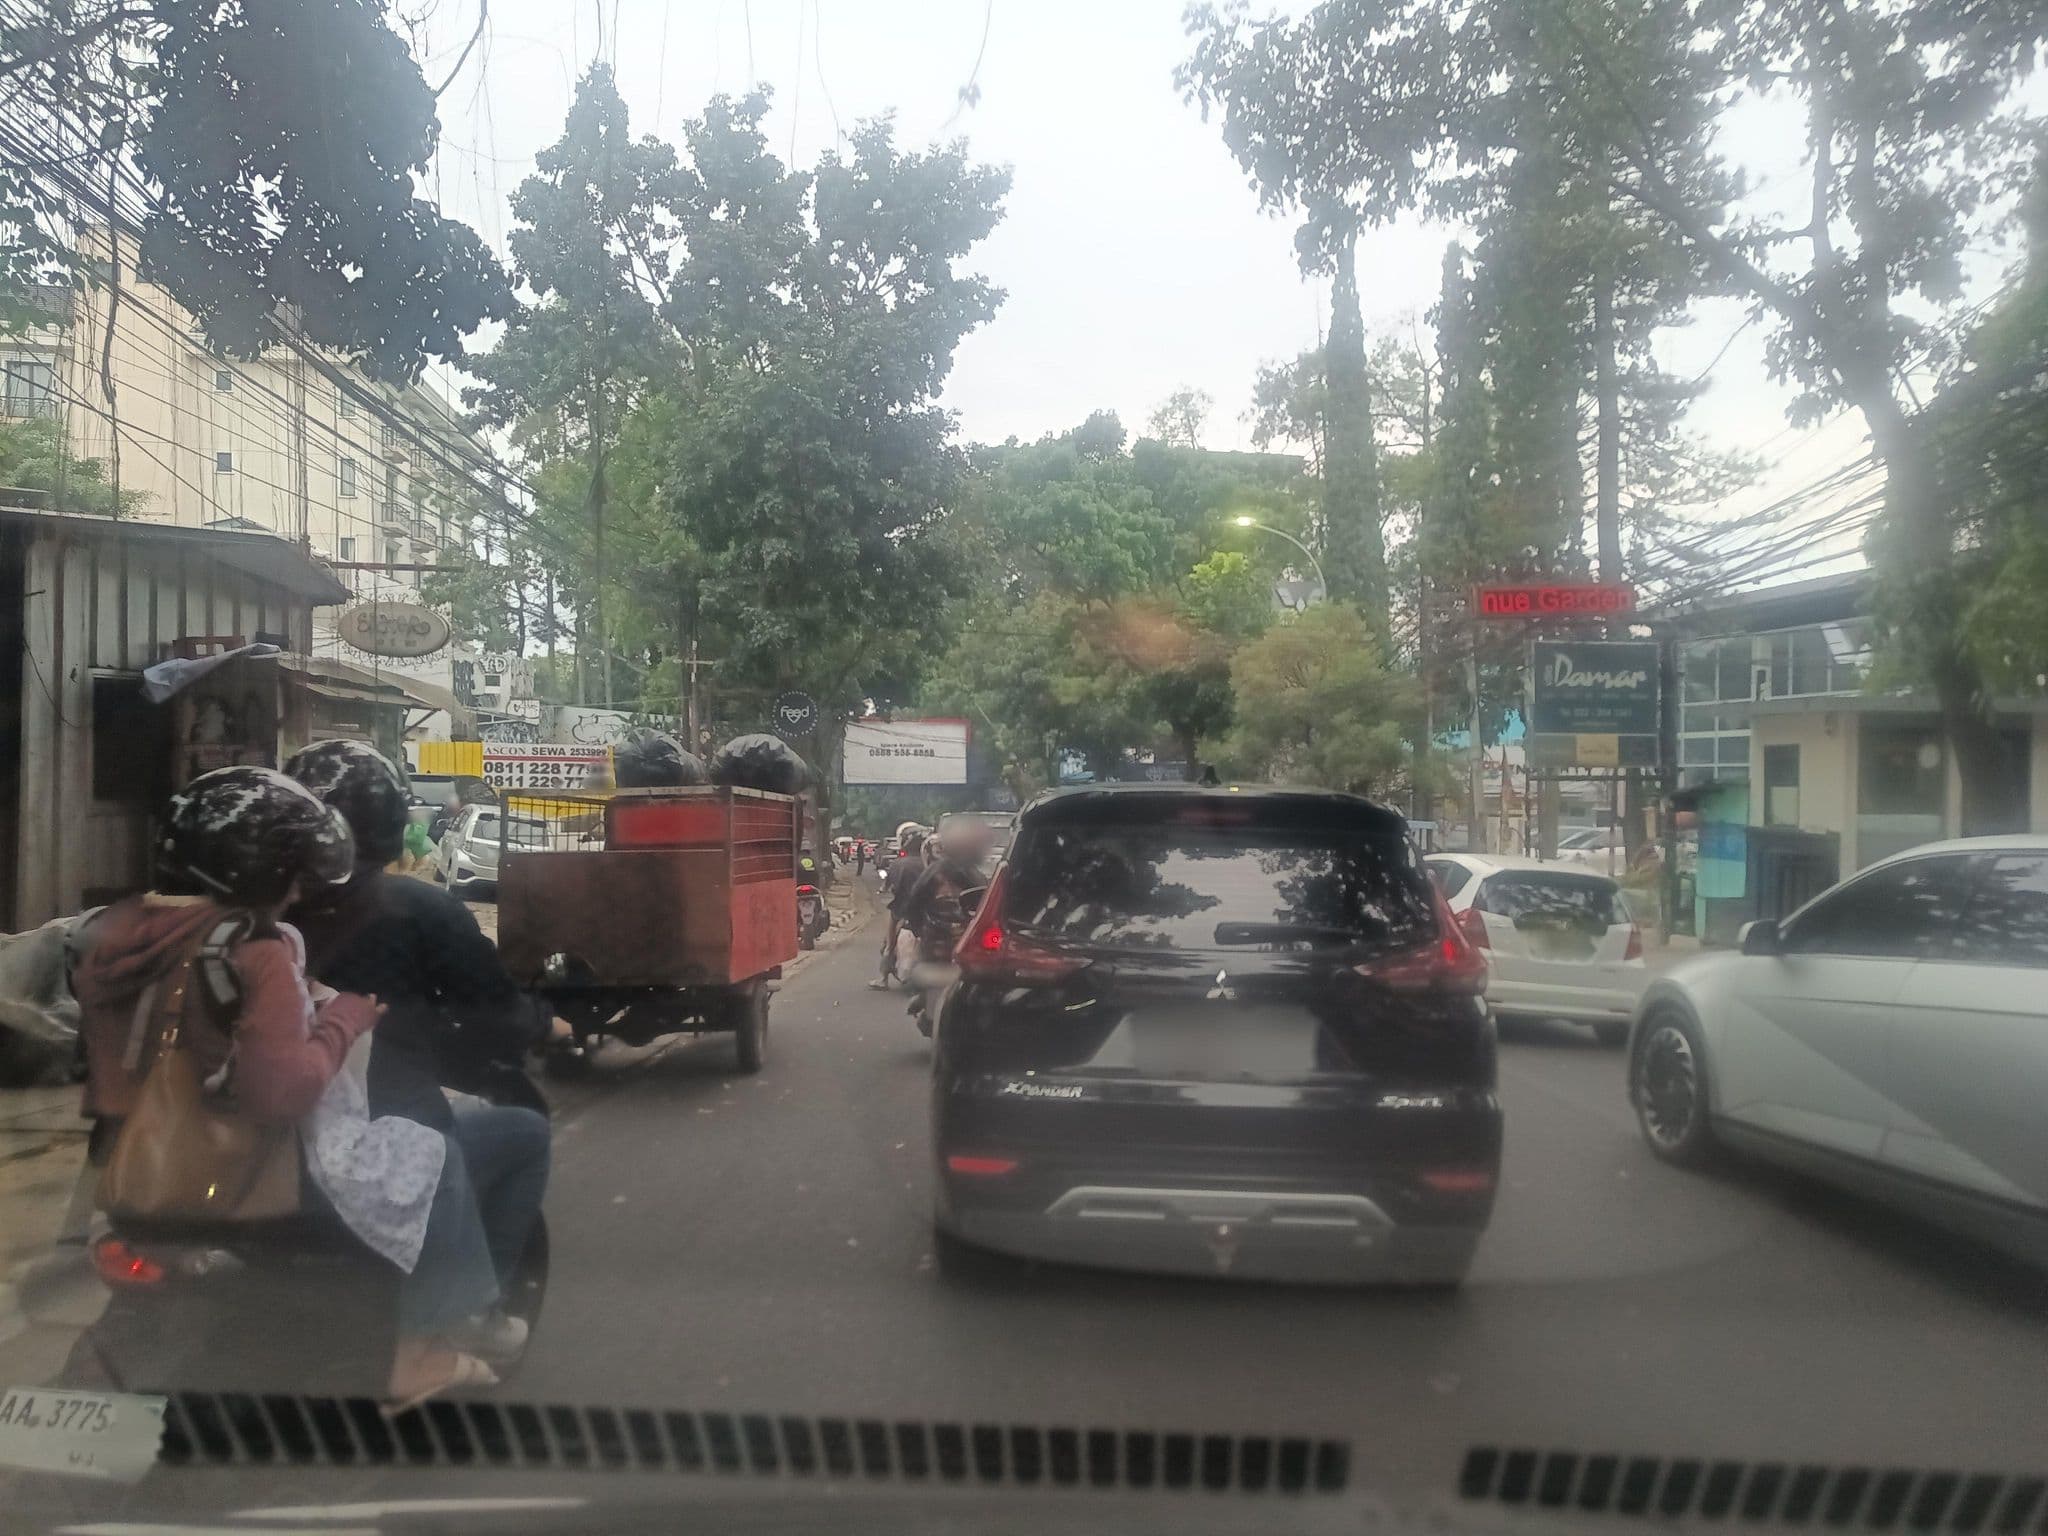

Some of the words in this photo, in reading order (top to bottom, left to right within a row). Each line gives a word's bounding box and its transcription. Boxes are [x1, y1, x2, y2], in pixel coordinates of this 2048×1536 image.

[1538, 587, 1631, 612] Garden
[1553, 653, 1647, 688] Damar
[485, 746, 526, 755] ASCON
[532, 747, 566, 756] SEWA
[484, 761, 524, 774] 0811
[529, 763, 561, 775] 228
[484, 775, 524, 788] 0811
[47, 1399, 113, 1432] 3775
